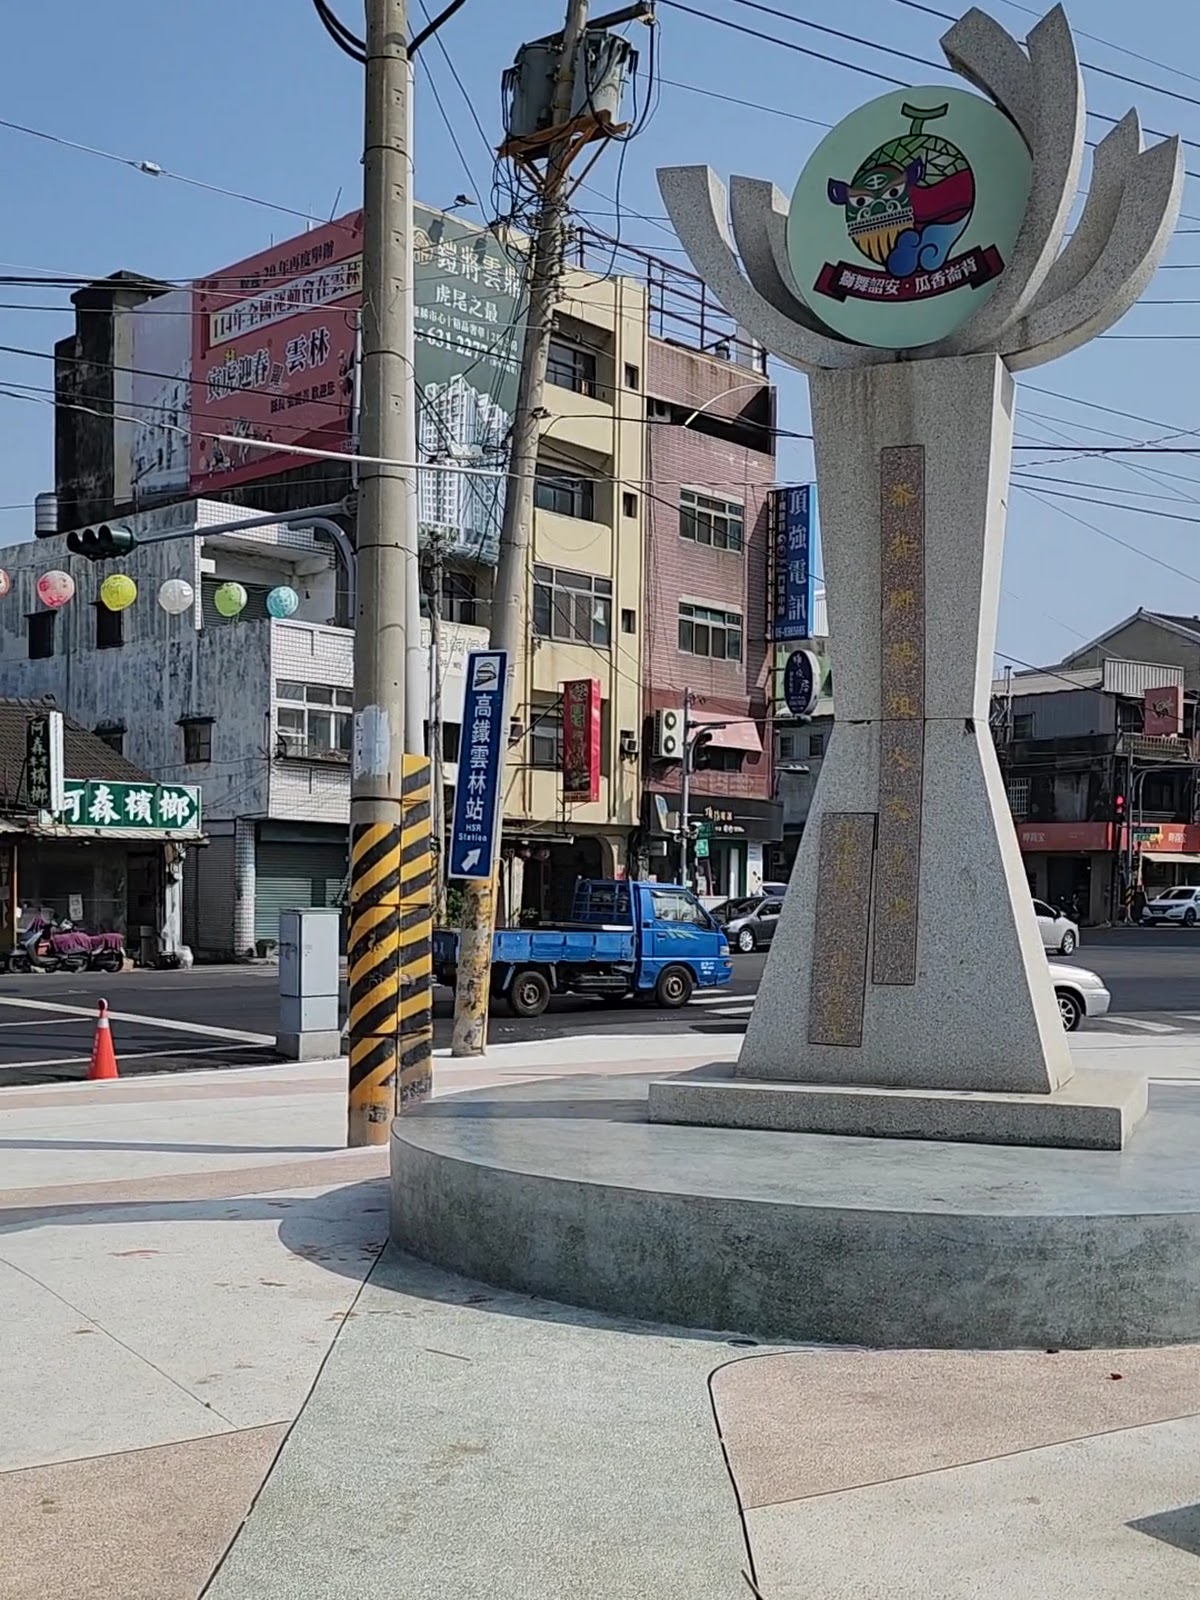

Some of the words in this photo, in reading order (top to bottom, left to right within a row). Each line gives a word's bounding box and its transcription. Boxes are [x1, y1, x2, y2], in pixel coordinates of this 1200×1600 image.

[435, 283, 498, 323] 虎尾之最
[286, 326, 331, 376] 雲林
[788, 489, 808, 622] 頂強電訊
[464, 693, 493, 821] 高鐵雲林站
[458, 832, 488, 842] Station
[465, 823, 482, 832] HSR
